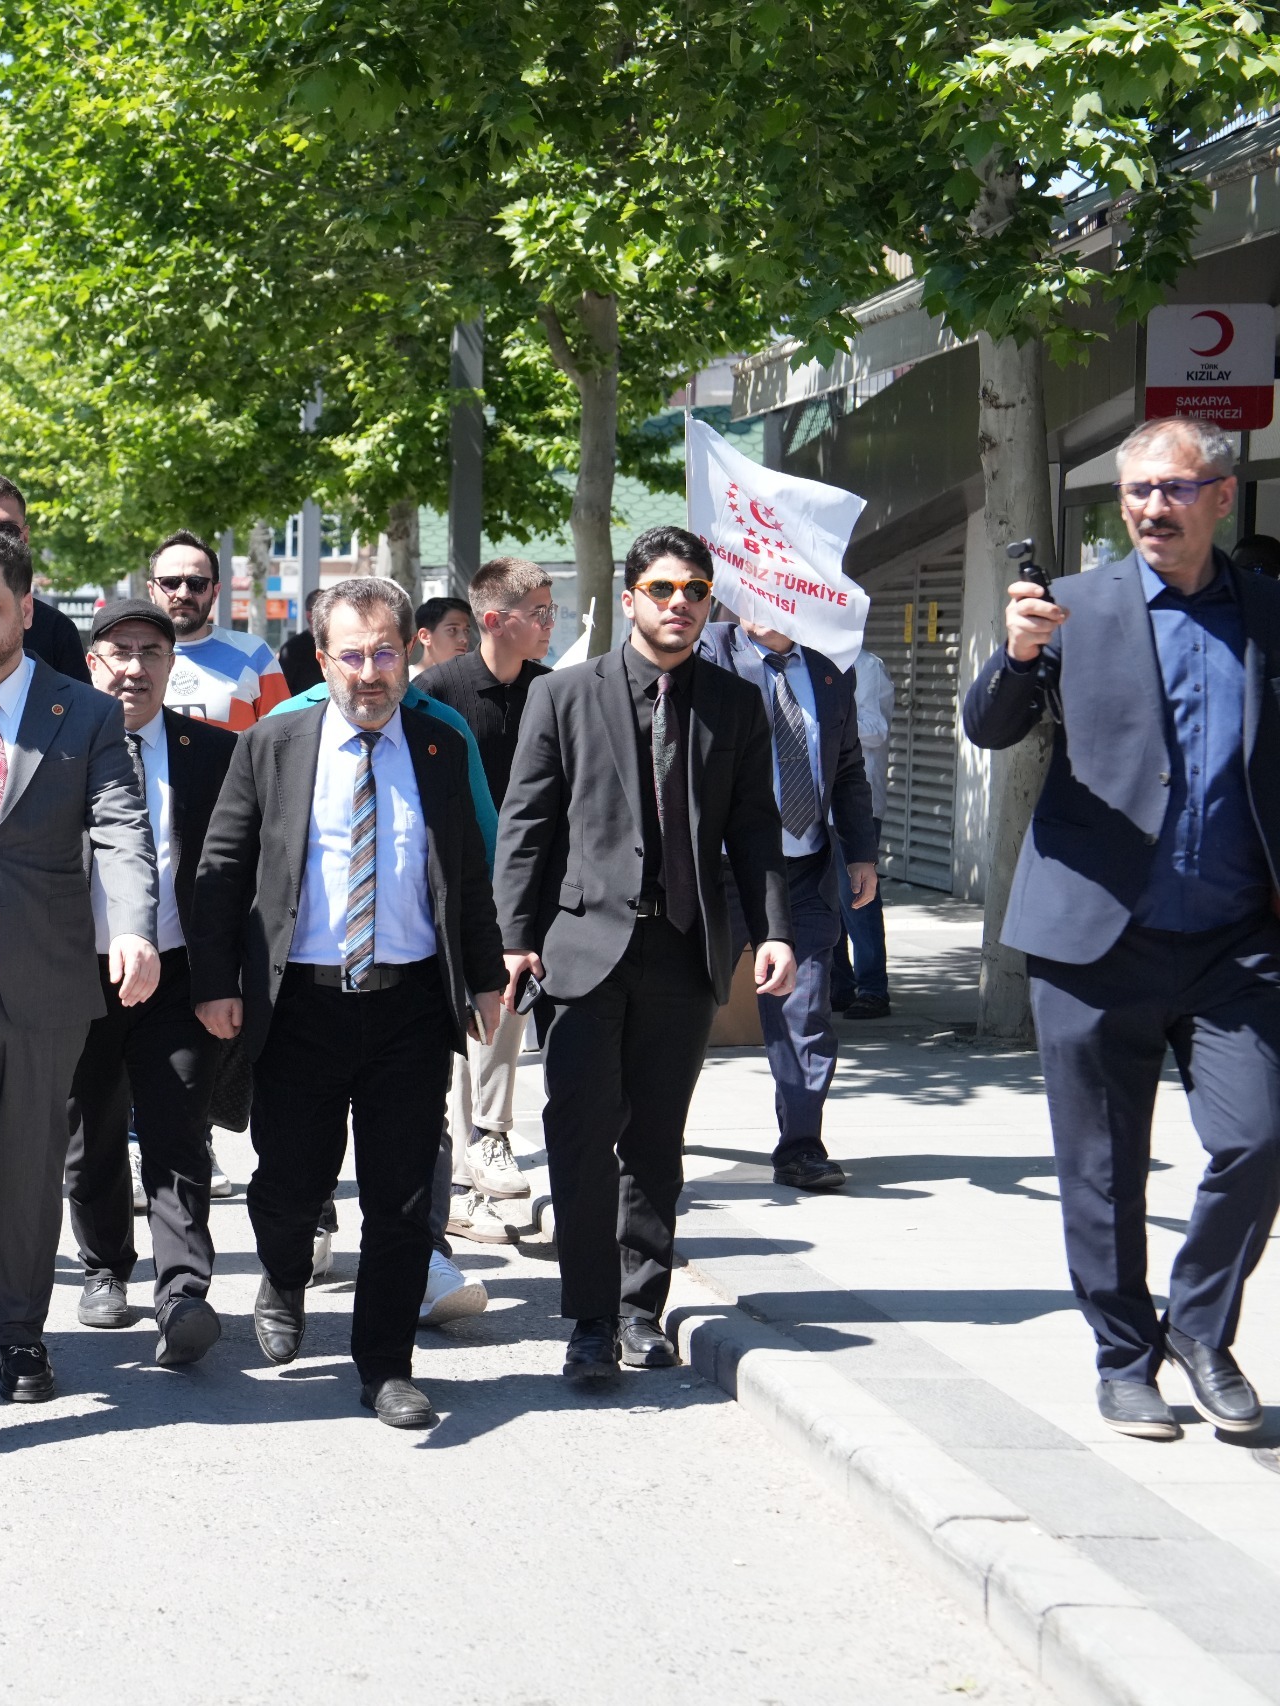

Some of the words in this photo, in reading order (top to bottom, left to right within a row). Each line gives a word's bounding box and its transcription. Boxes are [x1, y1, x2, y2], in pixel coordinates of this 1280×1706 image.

[1186, 370, 1232, 381] KIZILAY
[1176, 396, 1232, 406] SAKARYA
[1188, 407, 1242, 419] MERKEZİ
[699, 535, 770, 582] BAĞIMSIZ
[774, 572, 848, 607] TÜRKİYE
[739, 577, 796, 615] PARTİSİ
